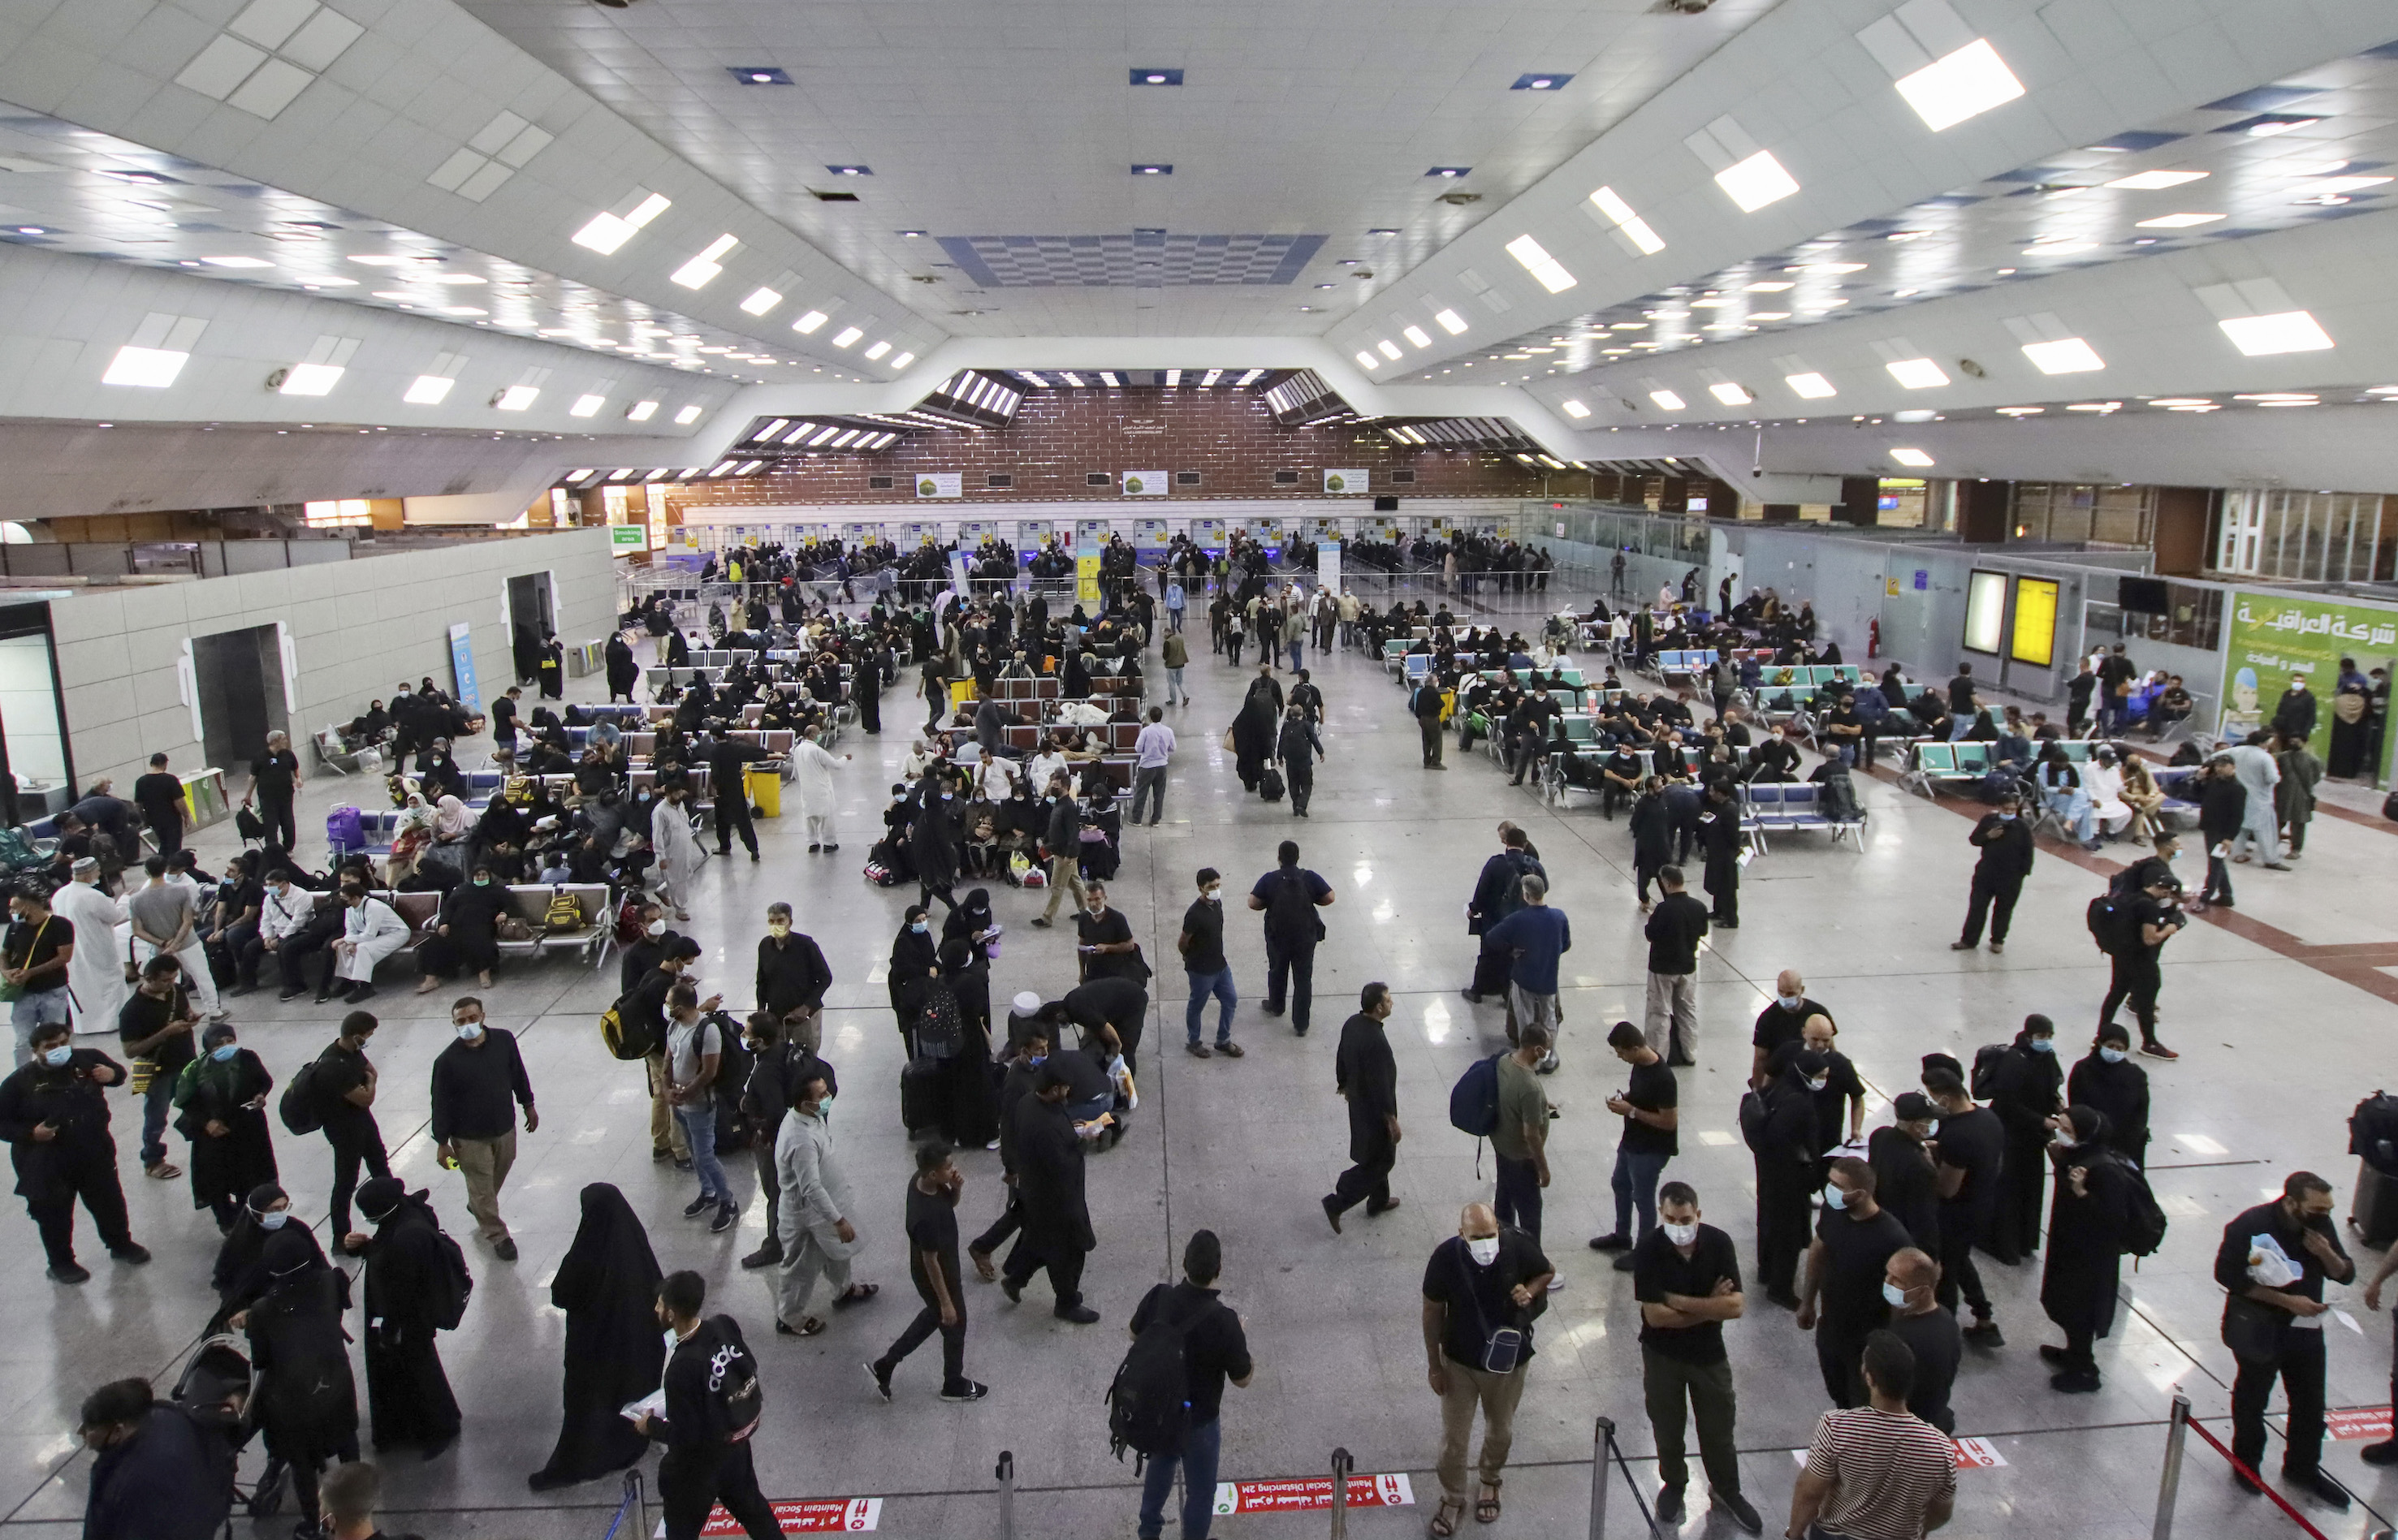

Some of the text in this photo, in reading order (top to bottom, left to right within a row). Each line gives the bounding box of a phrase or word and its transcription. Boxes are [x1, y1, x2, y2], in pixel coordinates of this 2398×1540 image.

[2331, 615, 2396, 646] شركة
[1242, 1485, 1255, 1494] 2M
[1258, 1483, 1304, 1494] Distancing
[1306, 1482, 1333, 1491] Social
[1277, 1495, 1312, 1506] بمسافة
[774, 1504, 802, 1515] Social
[804, 1503, 844, 1512] Maintain
[830, 1513, 840, 1525] م
